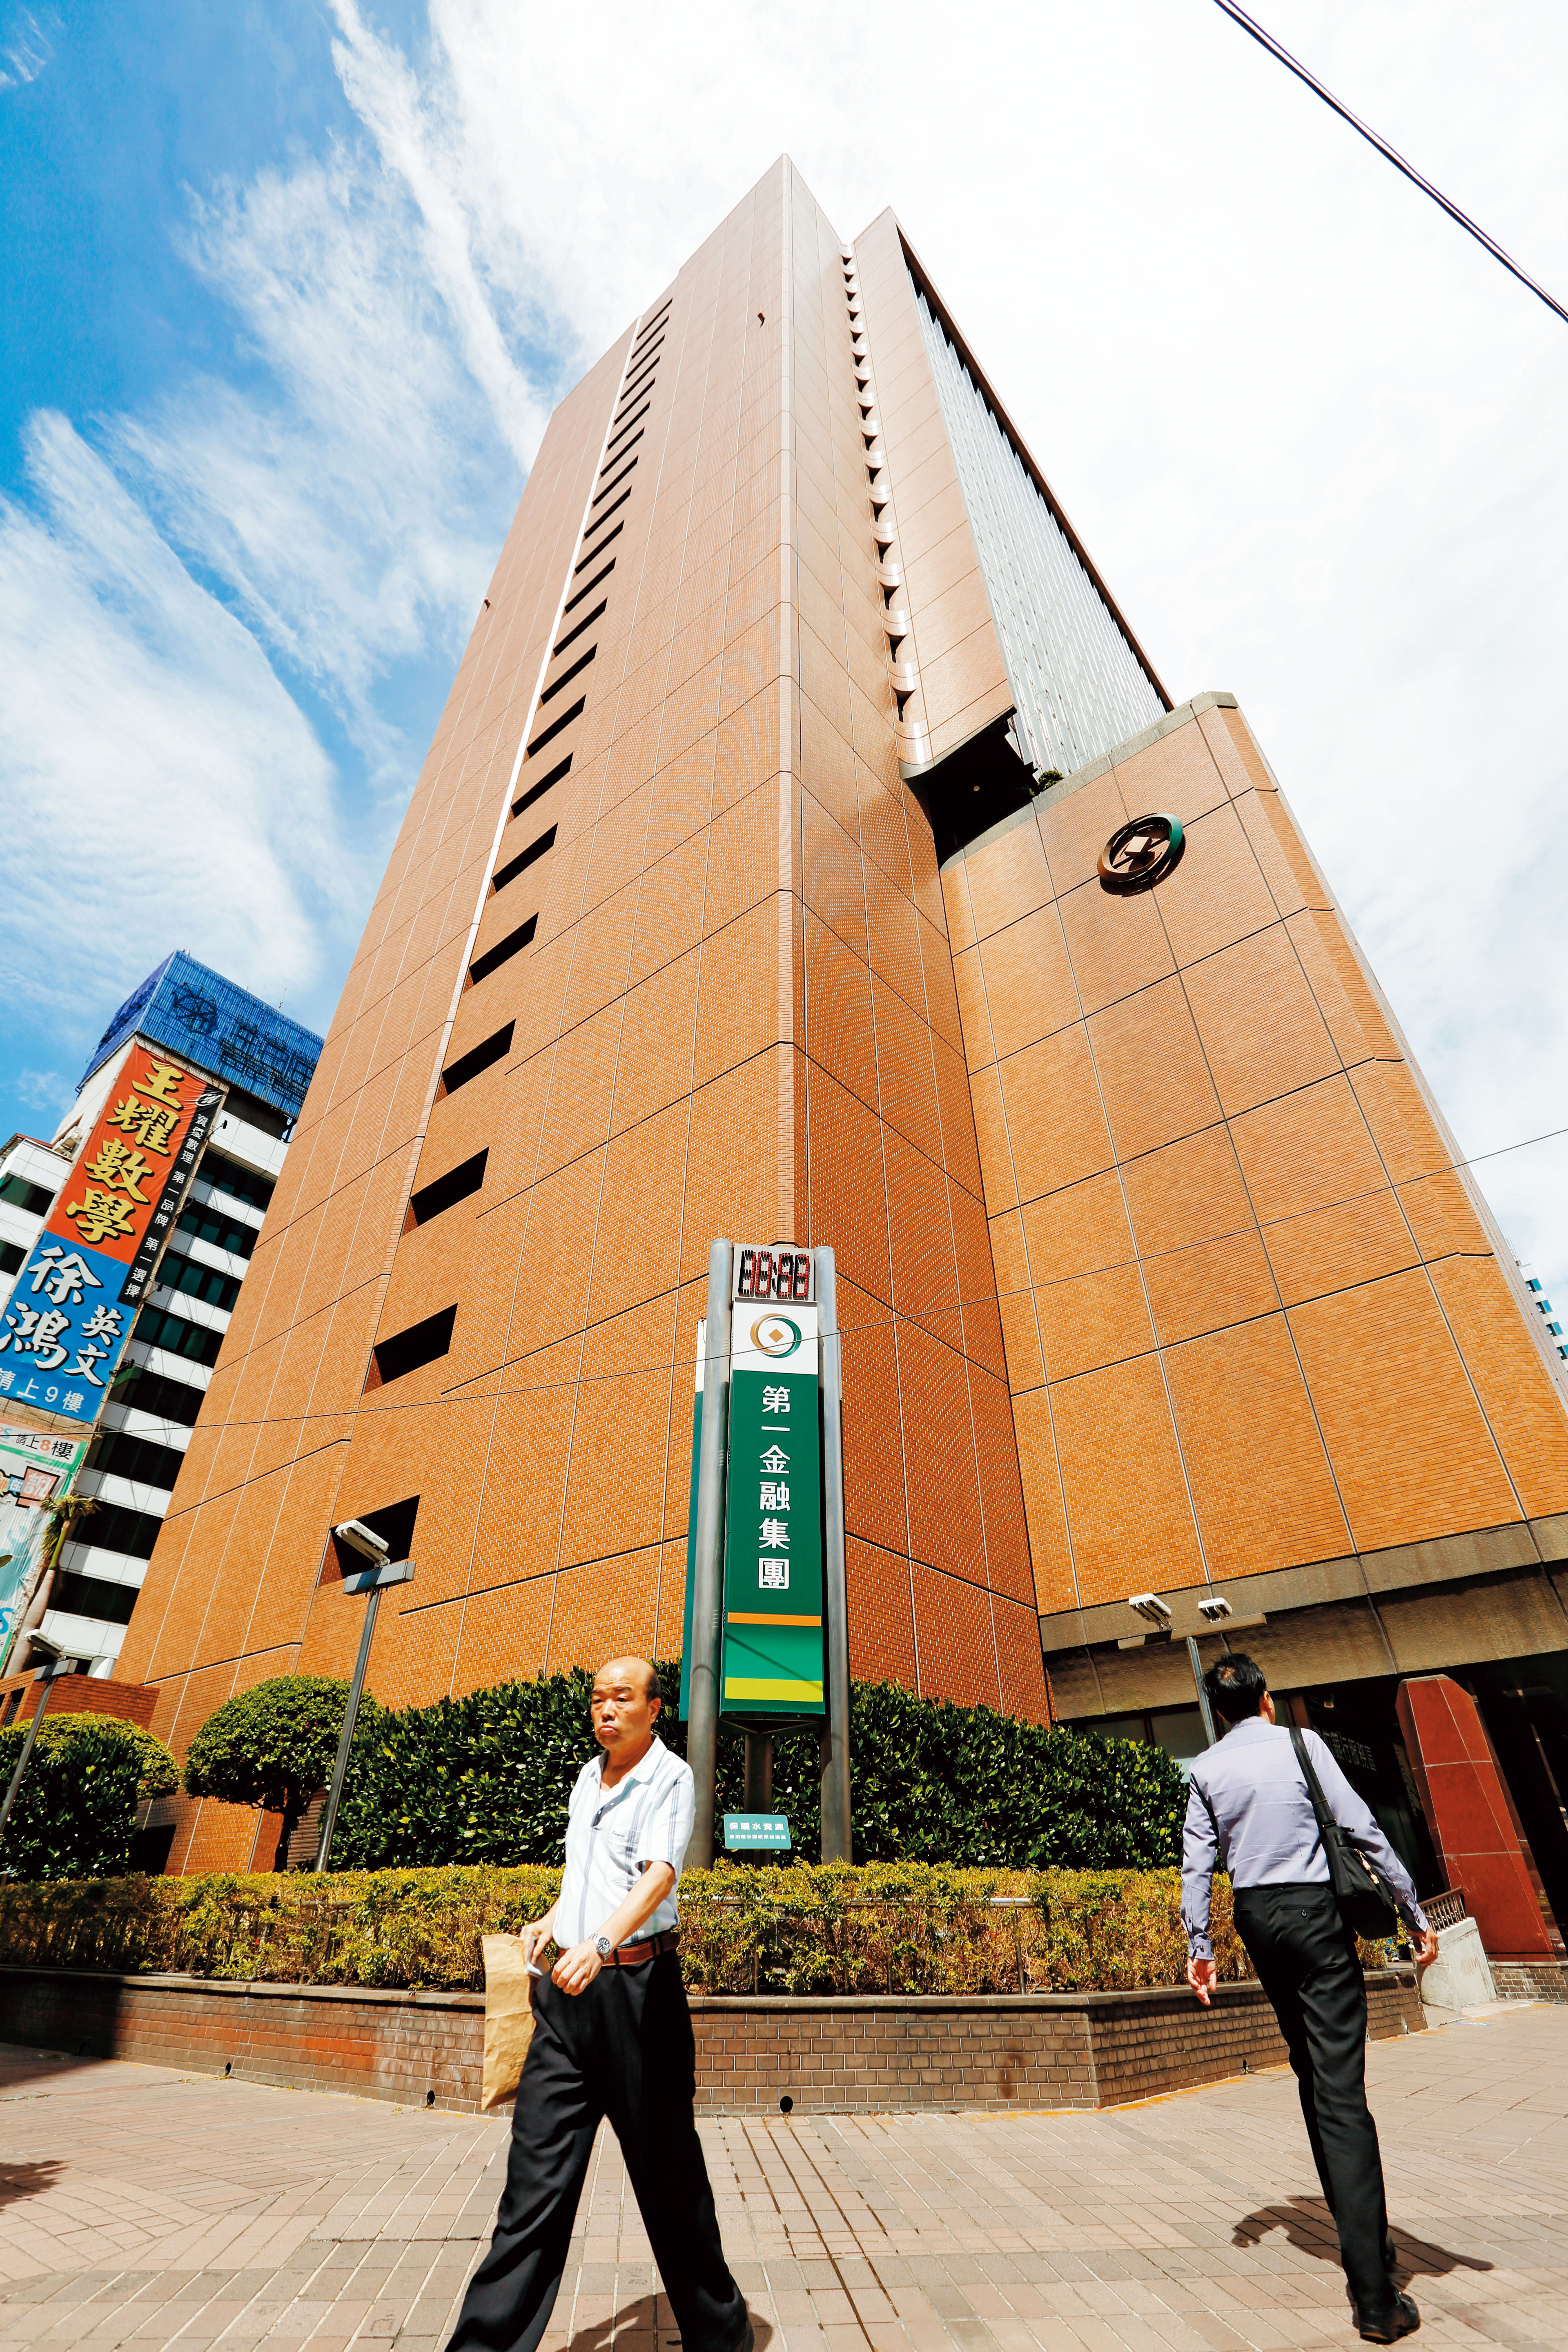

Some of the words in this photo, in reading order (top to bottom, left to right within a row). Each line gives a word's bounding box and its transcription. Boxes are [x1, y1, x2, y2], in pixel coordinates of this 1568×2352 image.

[66, 1060, 183, 1241] 王耀數學
[155, 1171, 186, 1227] 第一品牌
[125, 1237, 160, 1297] 第一選擇
[0, 1246, 102, 1369] 徐鴻
[63, 1305, 122, 1385] 英文
[0, 1368, 84, 1413] 請上9樓
[16, 1433, 74, 1460] 請上8樓
[758, 1385, 791, 1590] 第一金融集團
[729, 1822, 784, 1831] 保護水資源
